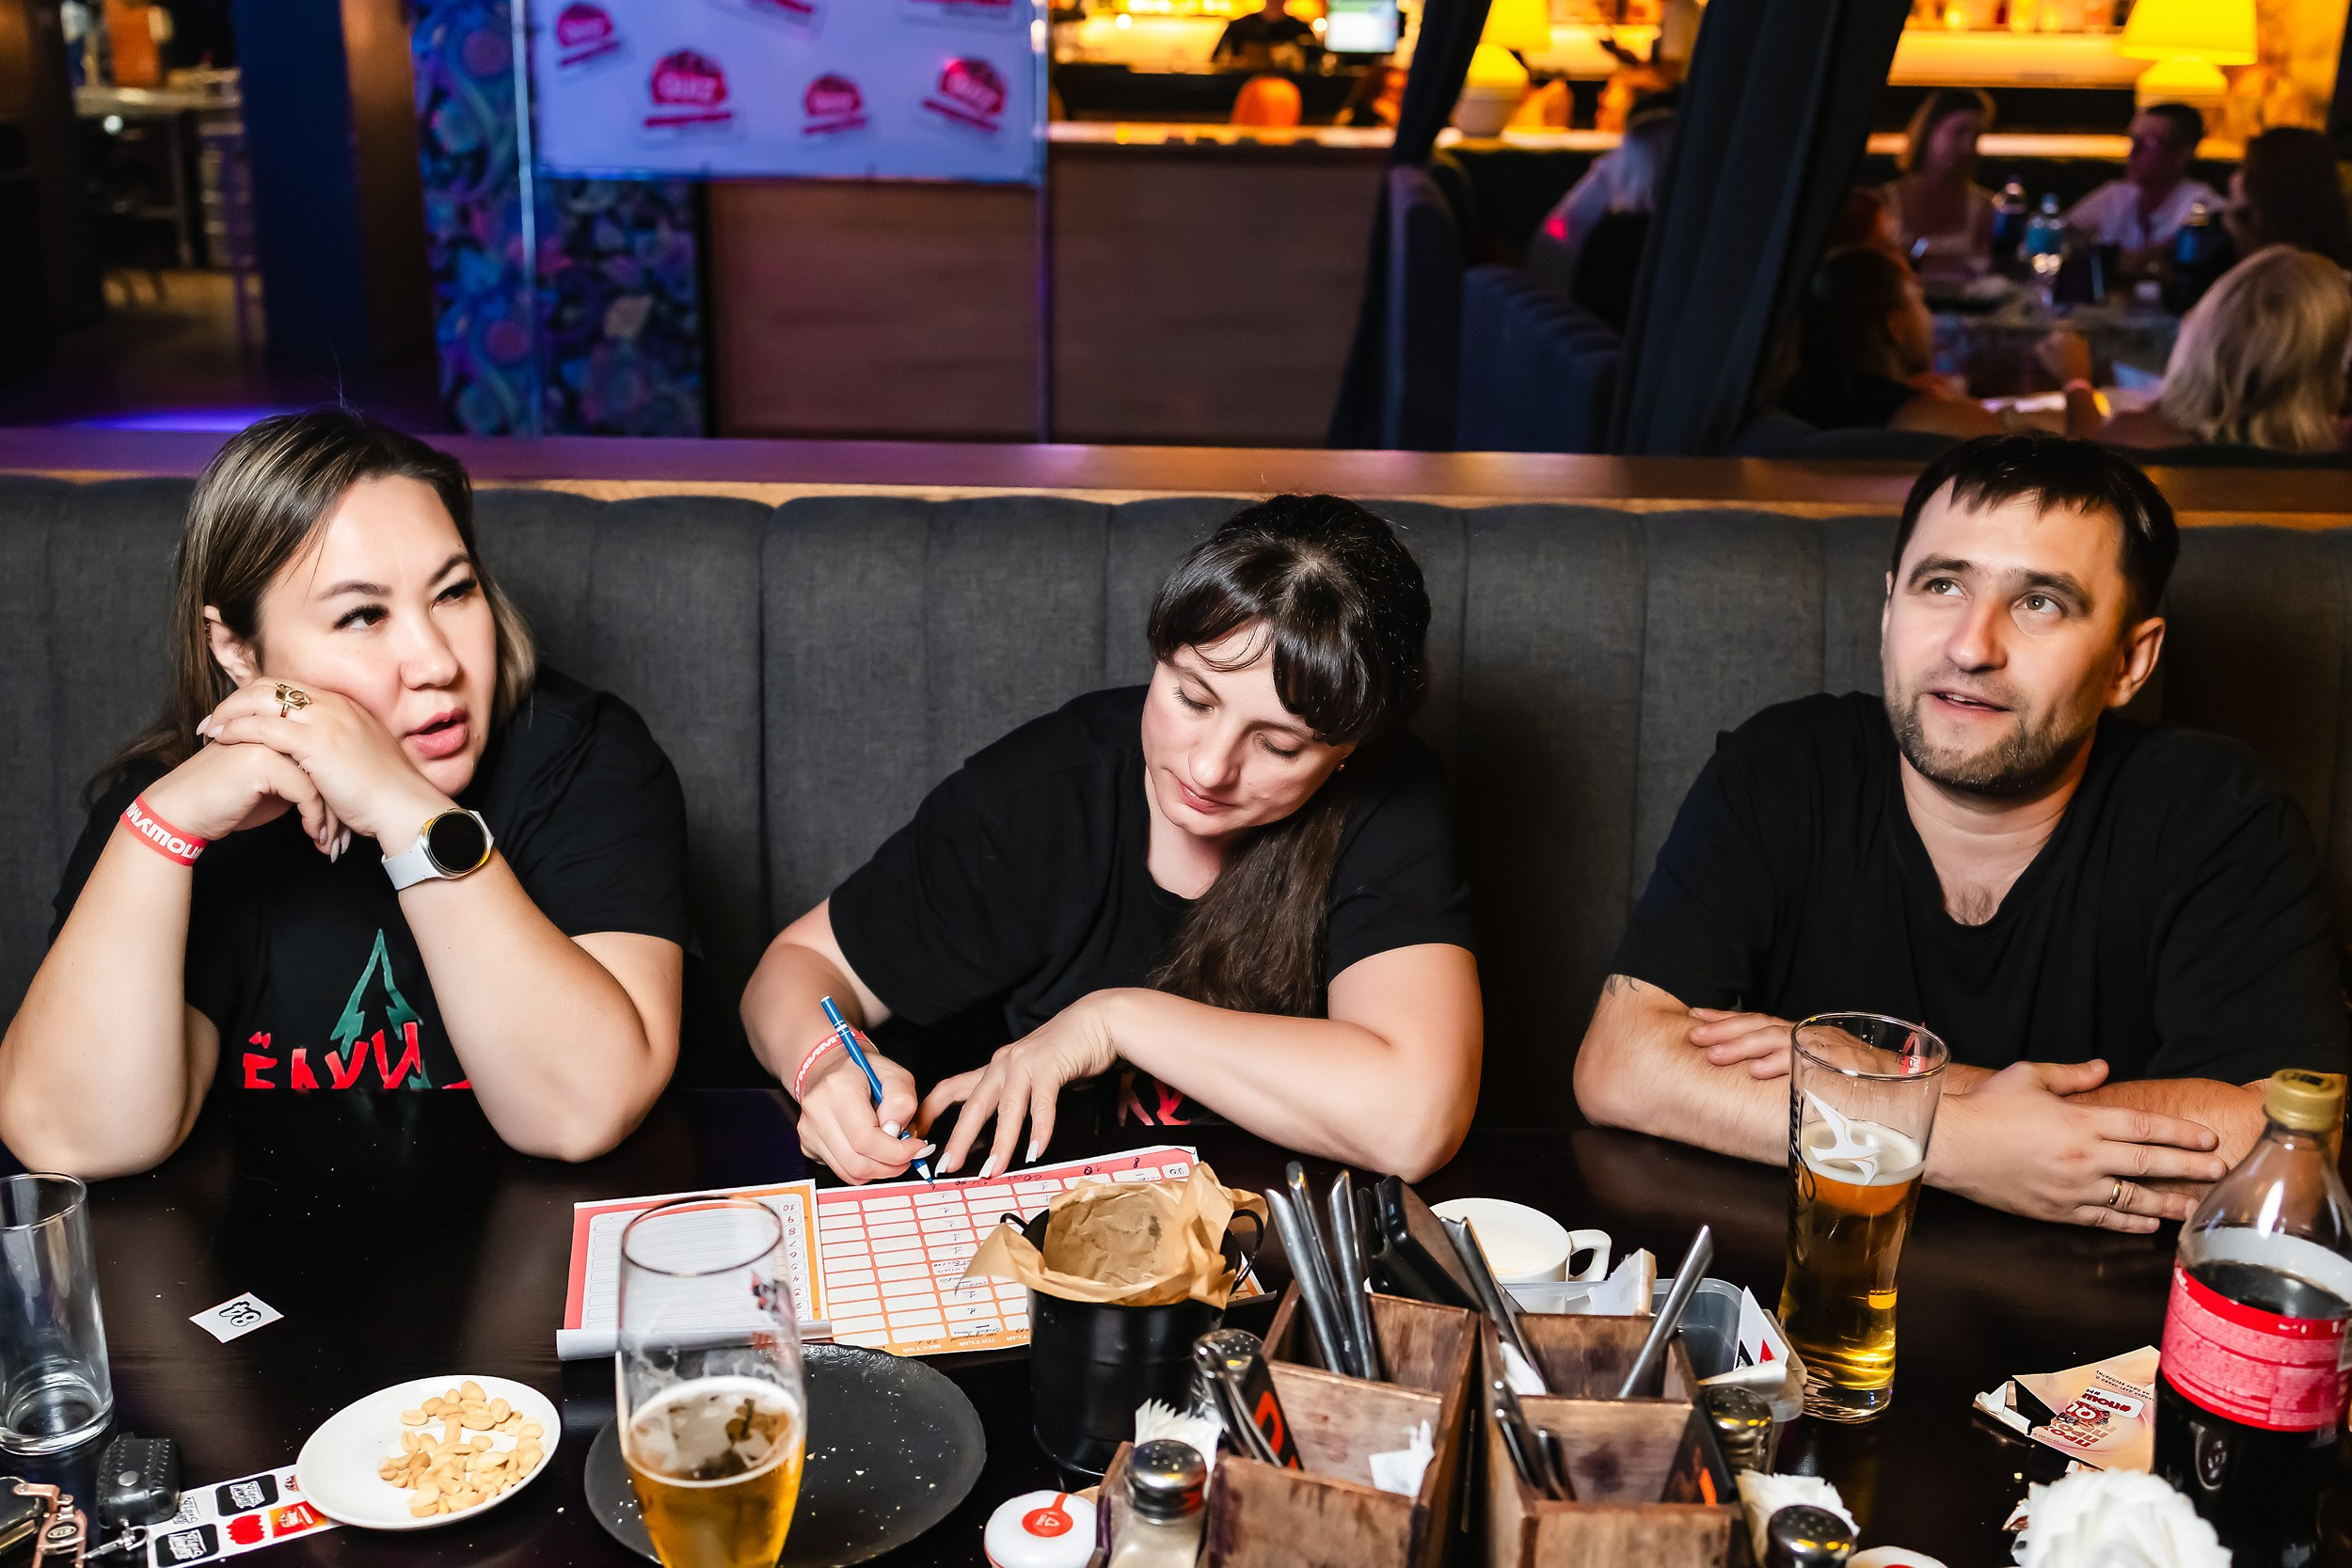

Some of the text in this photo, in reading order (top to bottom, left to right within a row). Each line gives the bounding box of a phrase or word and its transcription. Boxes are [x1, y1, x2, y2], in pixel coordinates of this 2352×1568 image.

[126, 801, 203, 860] ПОШУМ
[787, 1215, 794, 1224] 9
[788, 1227, 796, 1236] 8
[789, 1251, 798, 1259] 6
[790, 1262, 798, 1271] 5
[959, 1338, 995, 1346] ПЯТЫЙ
[902, 1344, 942, 1353] ШЕСТОЙ
